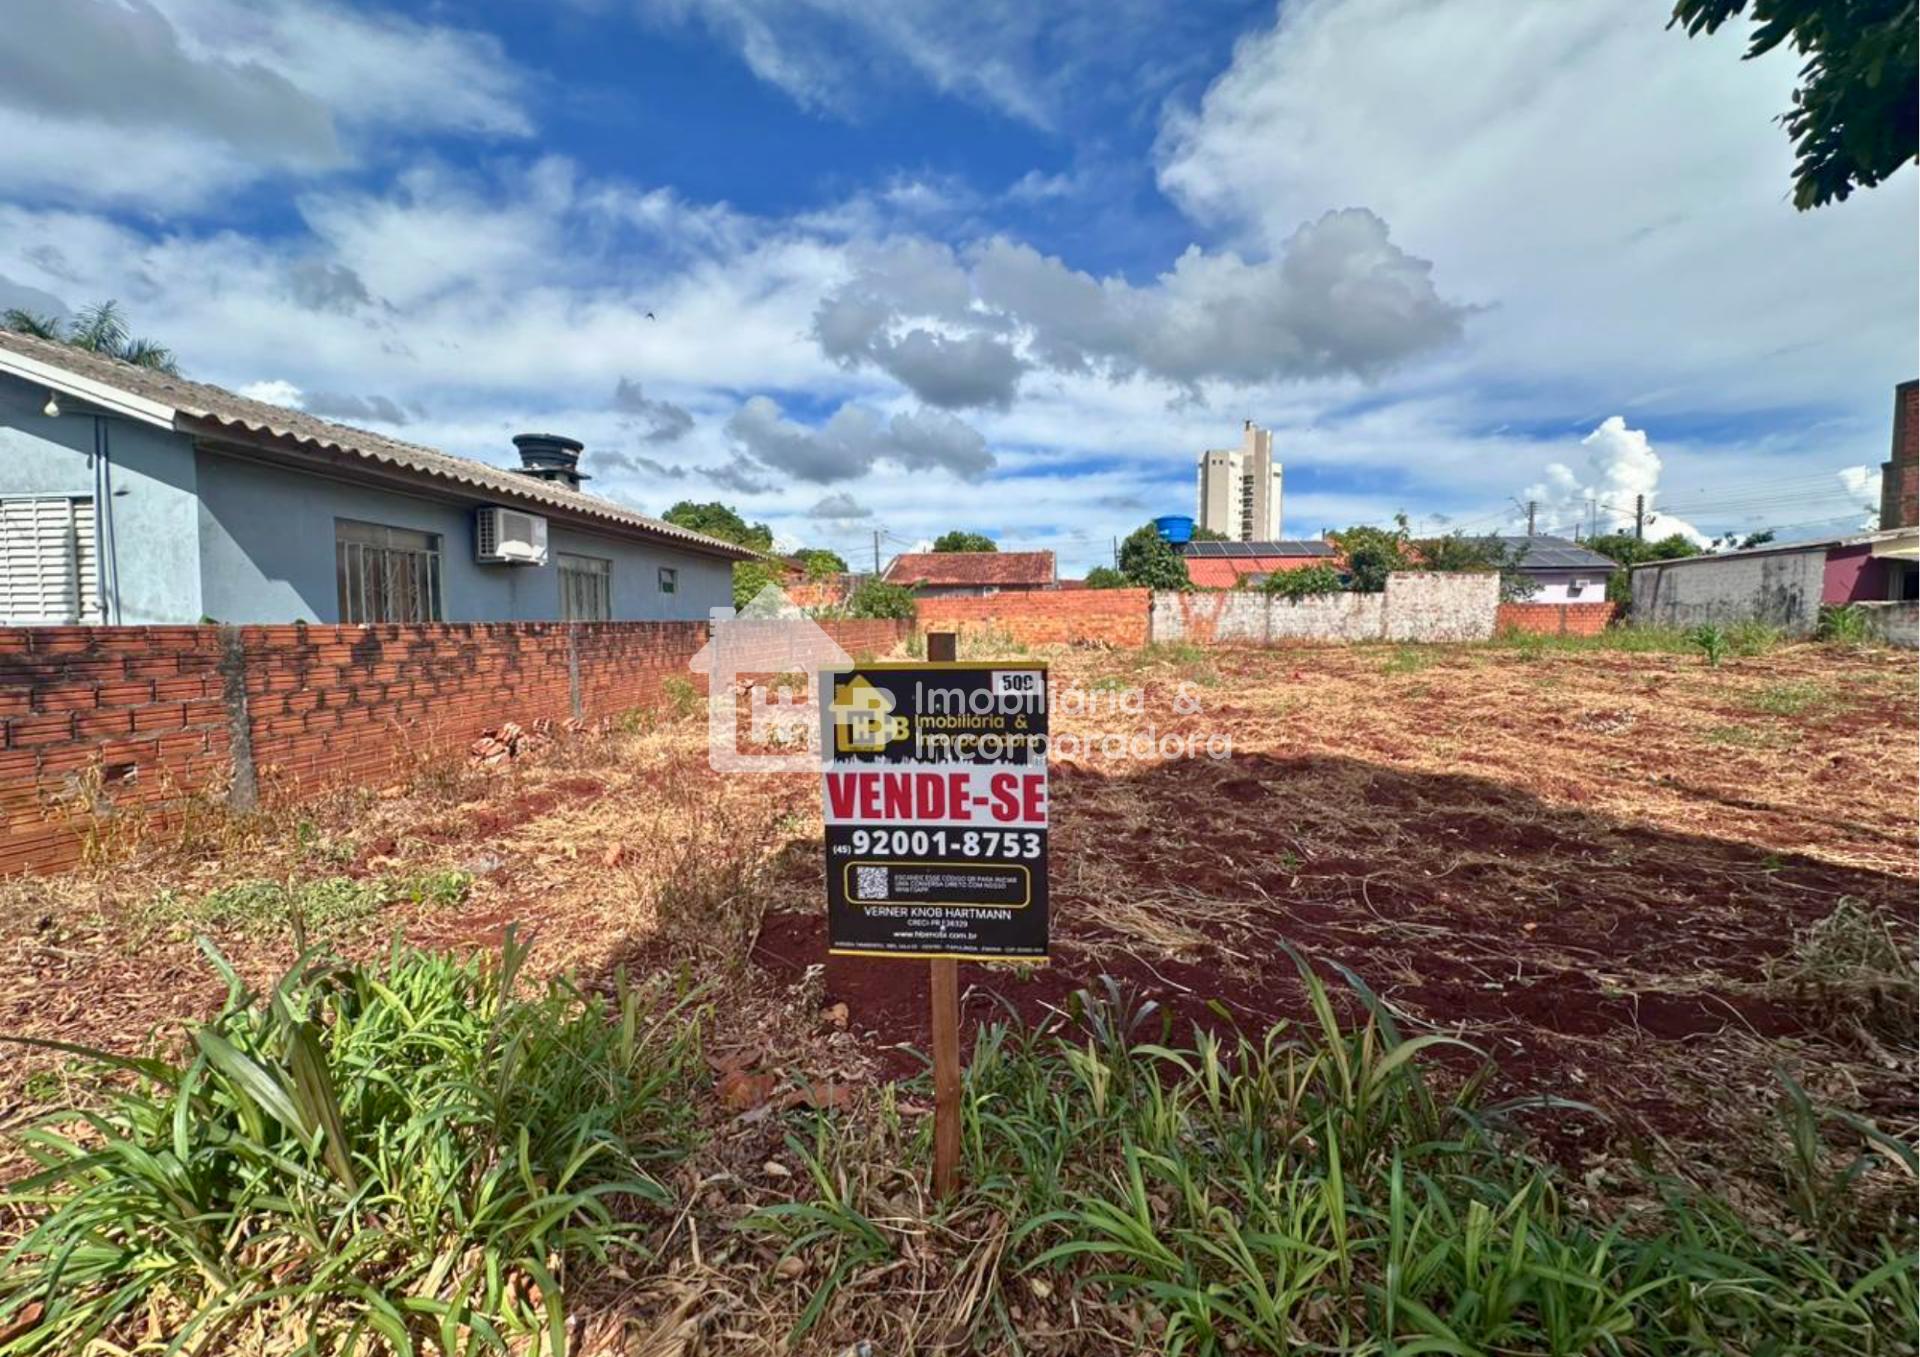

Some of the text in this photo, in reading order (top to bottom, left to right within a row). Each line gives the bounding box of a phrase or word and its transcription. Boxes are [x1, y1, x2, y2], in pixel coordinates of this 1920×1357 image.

[915, 713, 1028, 729] Imobiliária &
[915, 732, 1039, 751] Incorporadora
[826, 772, 1046, 823] VENDE-SE
[833, 829, 1041, 859] (45) 92001-8753
[864, 906, 1012, 921] VERNER KNOB HARTMANN
